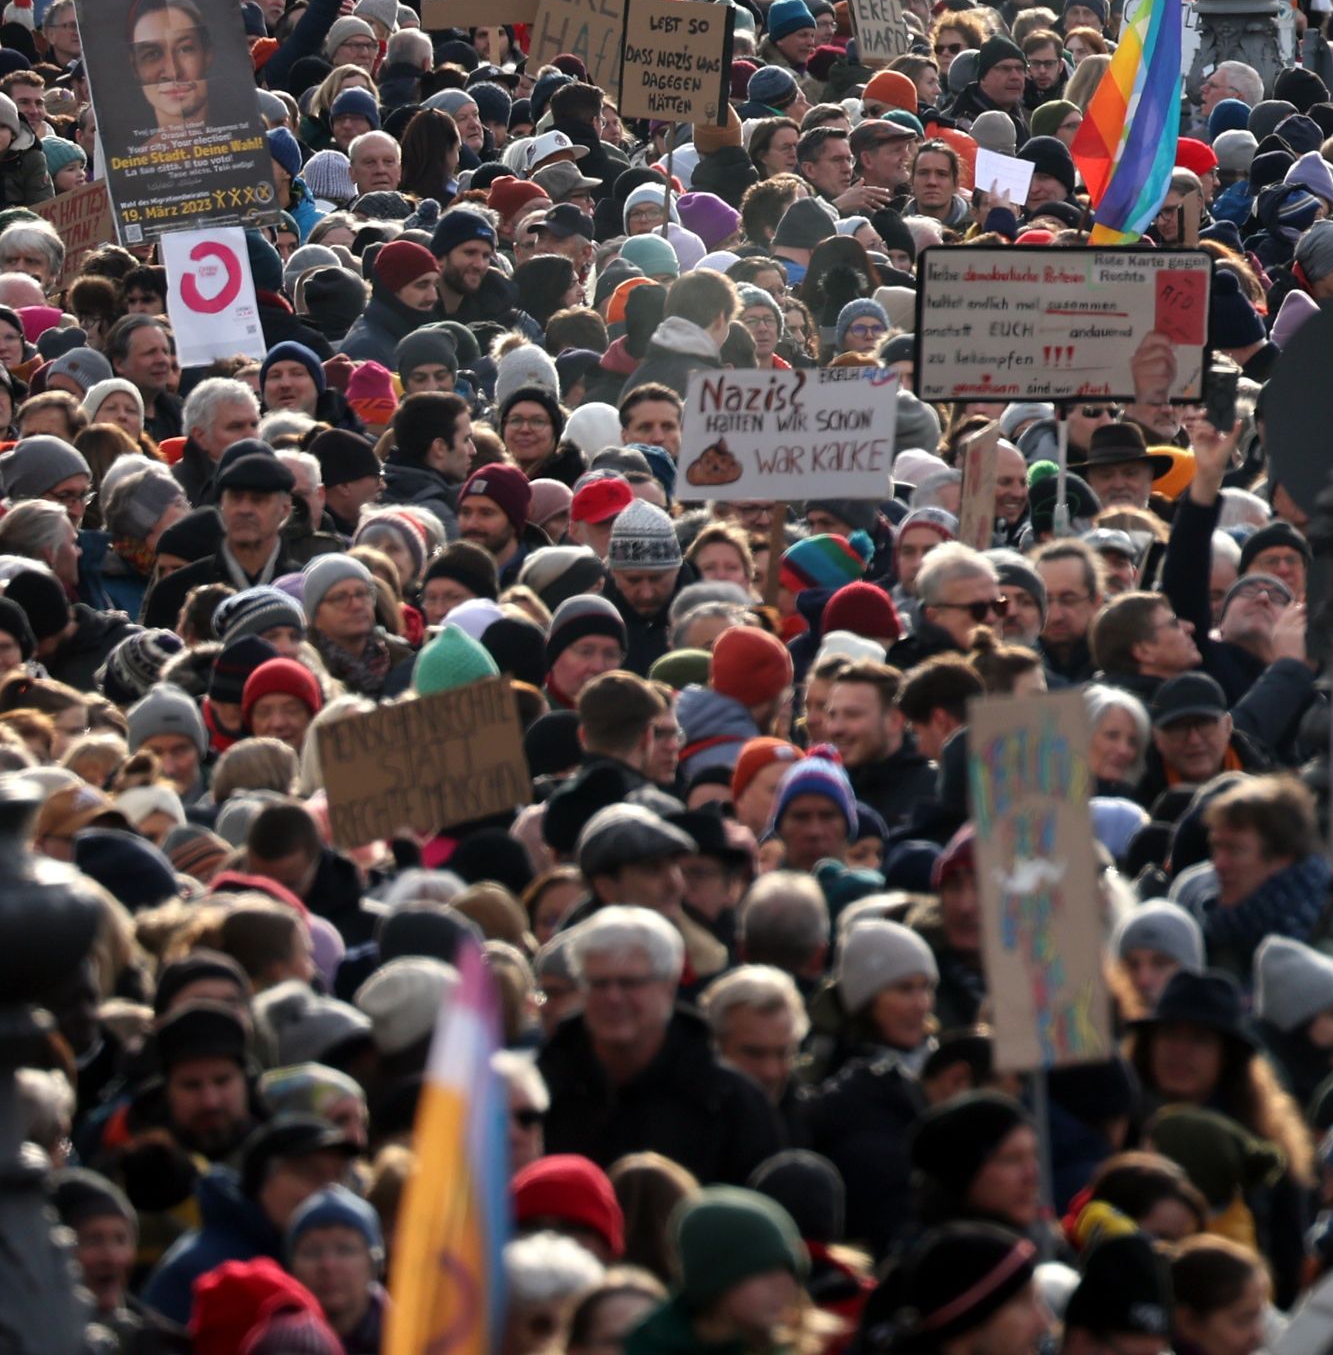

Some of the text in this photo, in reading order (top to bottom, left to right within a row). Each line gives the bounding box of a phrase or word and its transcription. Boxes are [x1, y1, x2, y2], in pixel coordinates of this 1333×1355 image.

[688, 17, 710, 35] SO
[625, 46, 652, 65] DASS
[696, 56, 720, 74] WAS
[642, 70, 702, 91] DAGEGEN
[172, 138, 192, 149] Your
[194, 132, 233, 145] election!
[111, 153, 149, 170] Deine
[152, 149, 191, 165] Stadt.
[193, 142, 229, 157] Deine
[231, 136, 264, 152] Wahl!
[193, 158, 209, 167] tuo
[210, 154, 233, 165] voto!
[120, 199, 137, 209] Wahl
[138, 198, 150, 207] des
[121, 198, 213, 222] 19. März 2023
[1128, 254, 1165, 268] Karte
[1168, 255, 1209, 269] gegen
[1099, 269, 1146, 283] Rechts
[967, 294, 1009, 310] endlich
[1016, 296, 1040, 310] mal
[1046, 300, 1118, 311] zusammen
[989, 322, 1034, 337] EUCH
[1069, 323, 1133, 337] andauernd
[923, 383, 944, 394] nur
[1026, 380, 1051, 395] sind
[1055, 383, 1072, 395] wir
